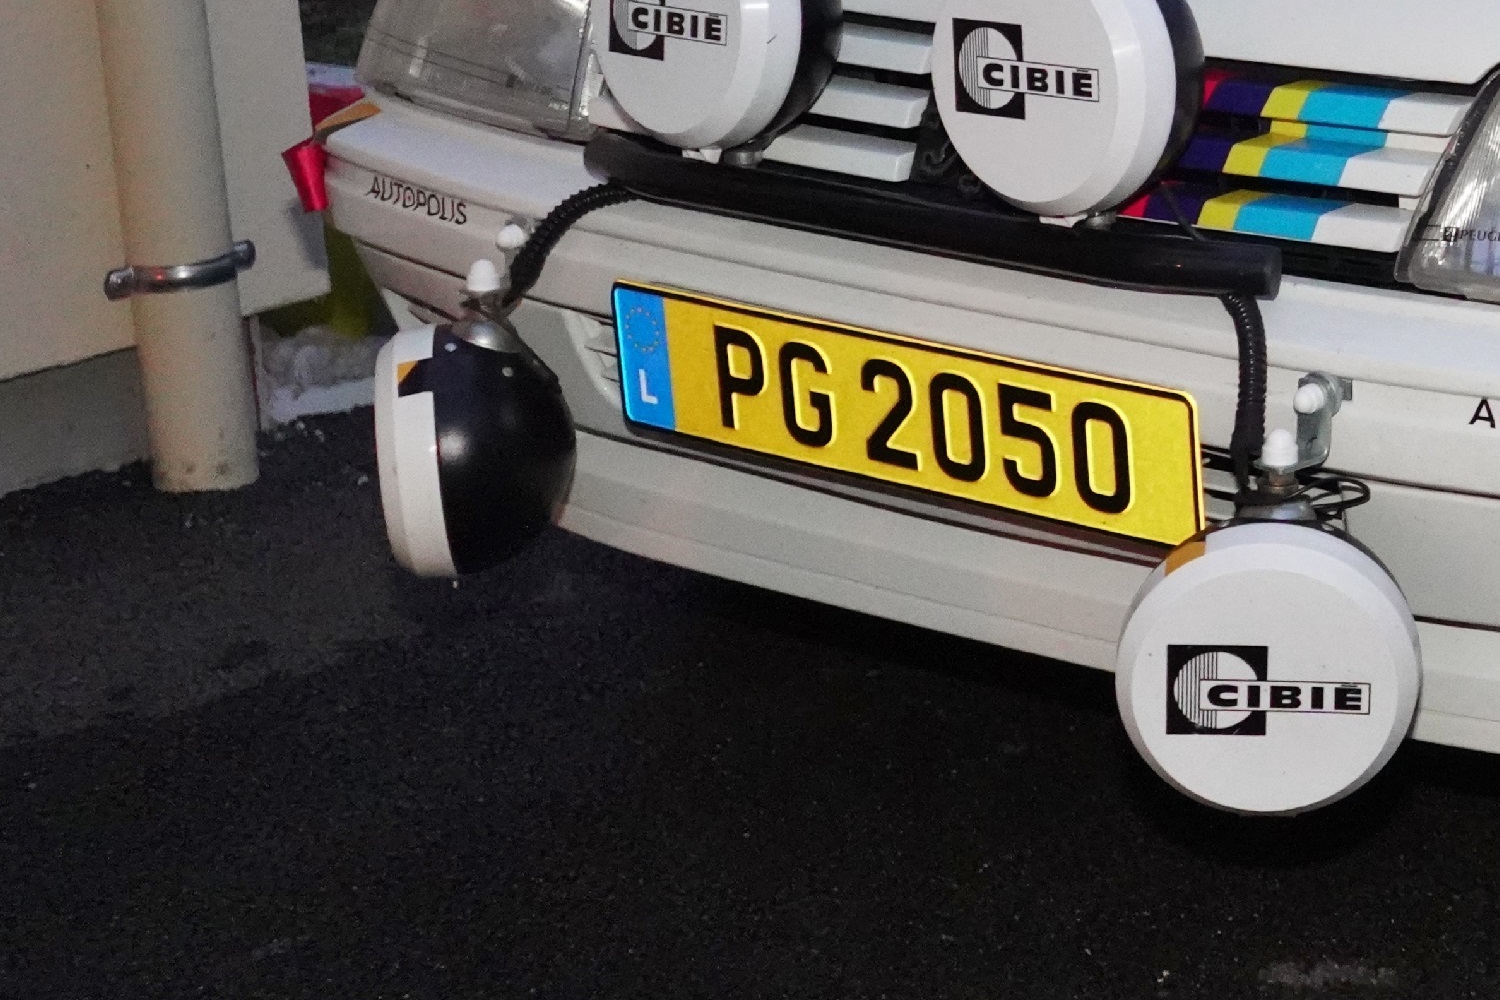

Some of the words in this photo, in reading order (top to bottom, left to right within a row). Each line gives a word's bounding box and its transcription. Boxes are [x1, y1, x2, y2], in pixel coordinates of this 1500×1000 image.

[365, 176, 467, 225] AUTOPOLIS
[638, 368, 659, 405] L
[712, 324, 836, 449] PG
[860, 358, 1133, 515] 2050
